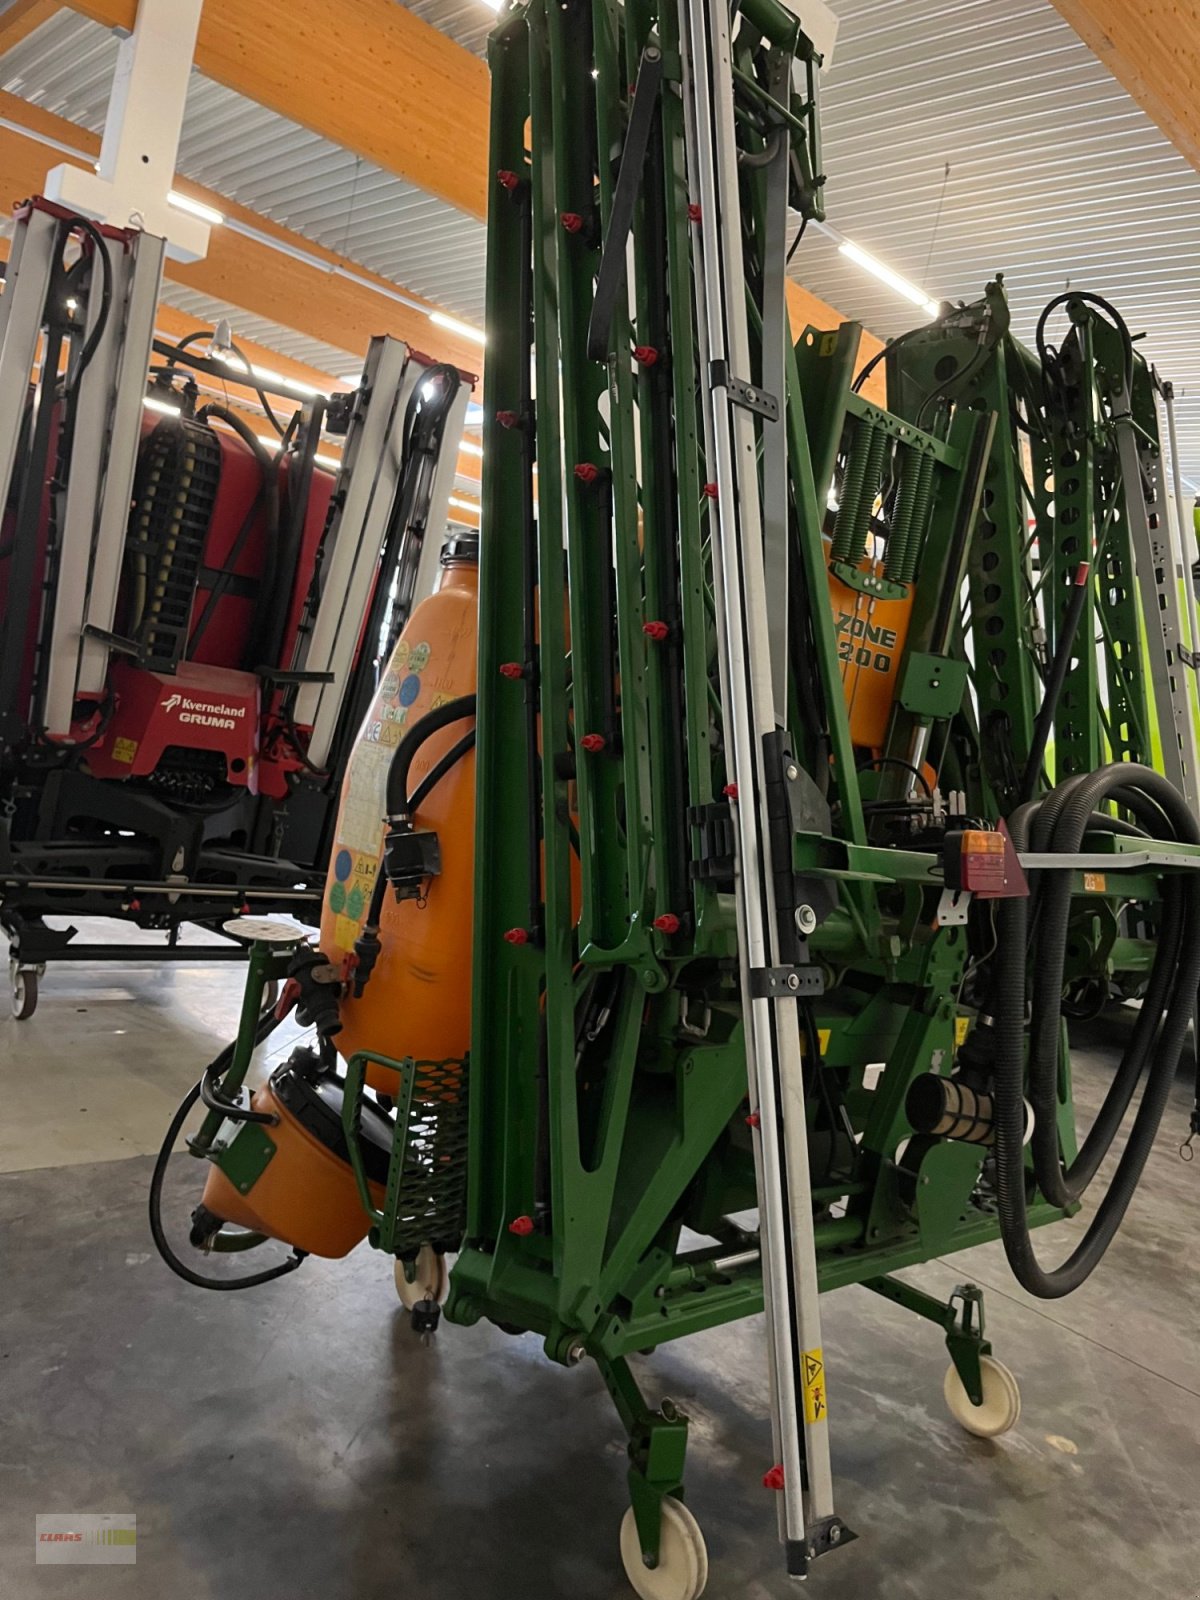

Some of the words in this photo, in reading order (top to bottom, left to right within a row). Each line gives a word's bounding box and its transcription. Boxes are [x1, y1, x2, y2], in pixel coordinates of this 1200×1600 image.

[835, 611, 897, 650] ZONE
[181, 698, 246, 718] Kverneland
[179, 712, 236, 730] GRUMA
